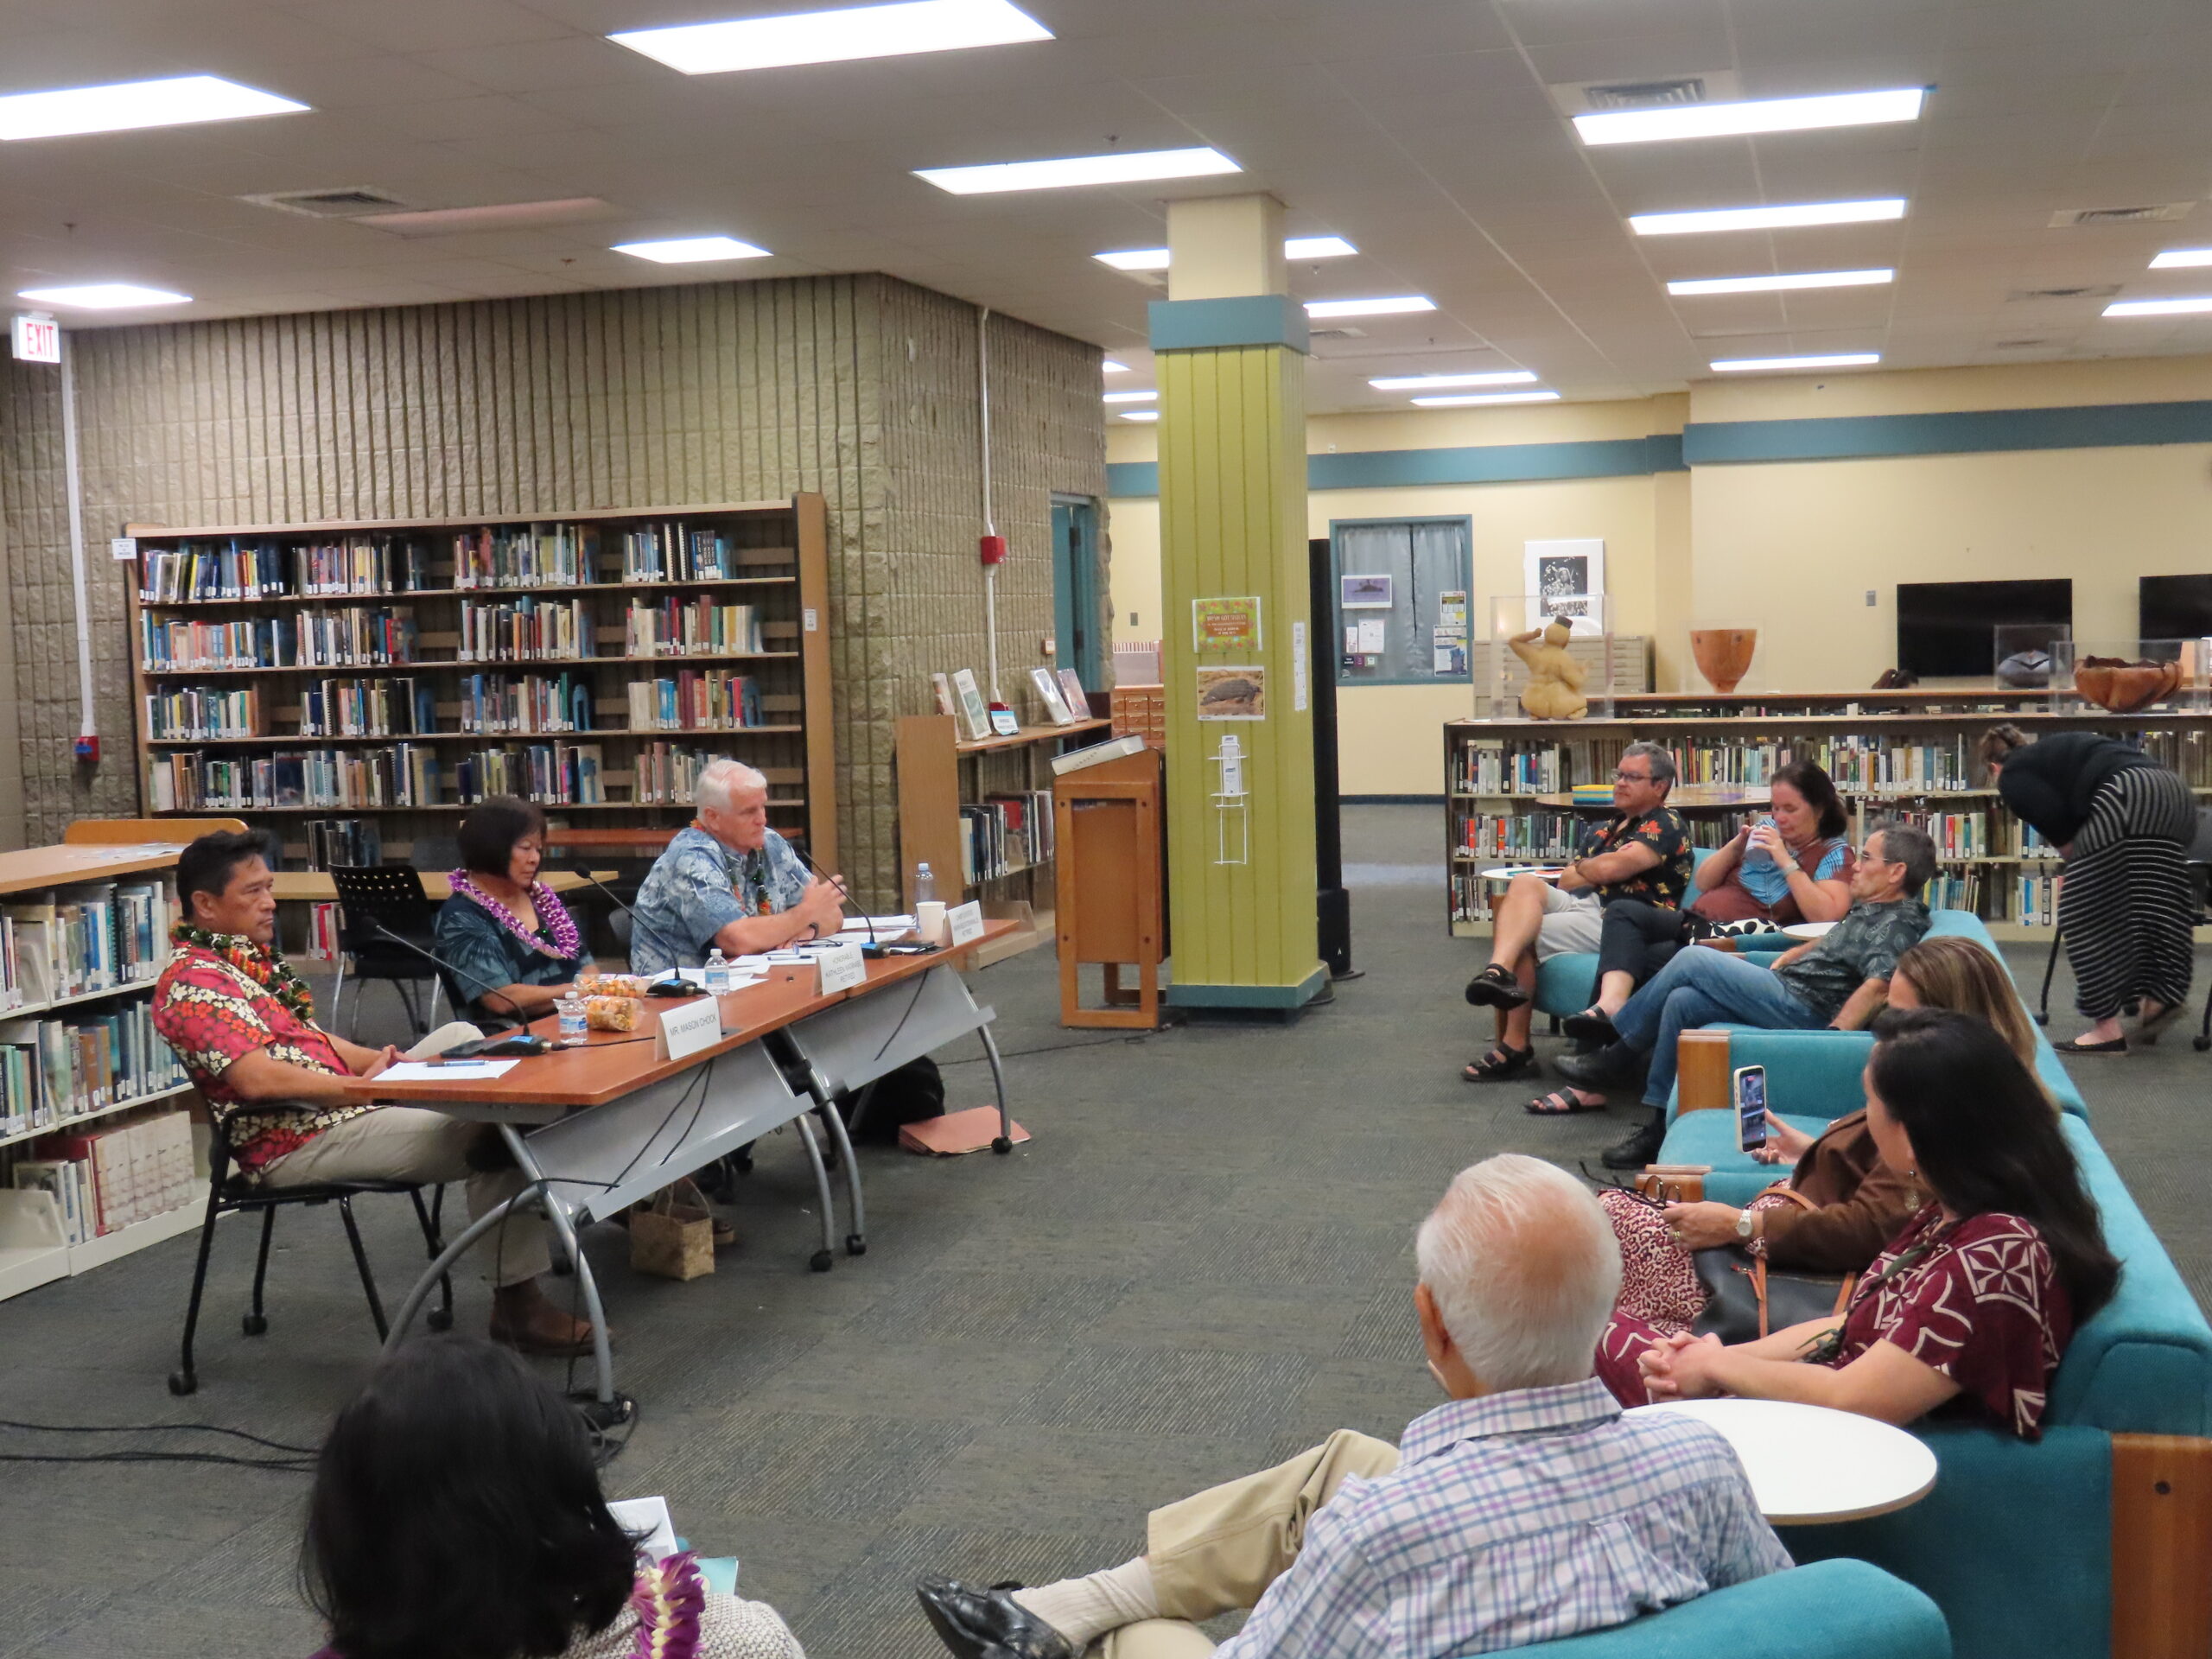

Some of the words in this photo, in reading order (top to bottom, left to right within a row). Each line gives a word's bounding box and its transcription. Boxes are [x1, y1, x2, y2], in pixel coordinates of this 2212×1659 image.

[26, 322, 54, 357] EXIT
[670, 1026, 680, 1037] MR.
[680, 1019, 699, 1033] MASON
[700, 1014, 717, 1027] CHOCK
